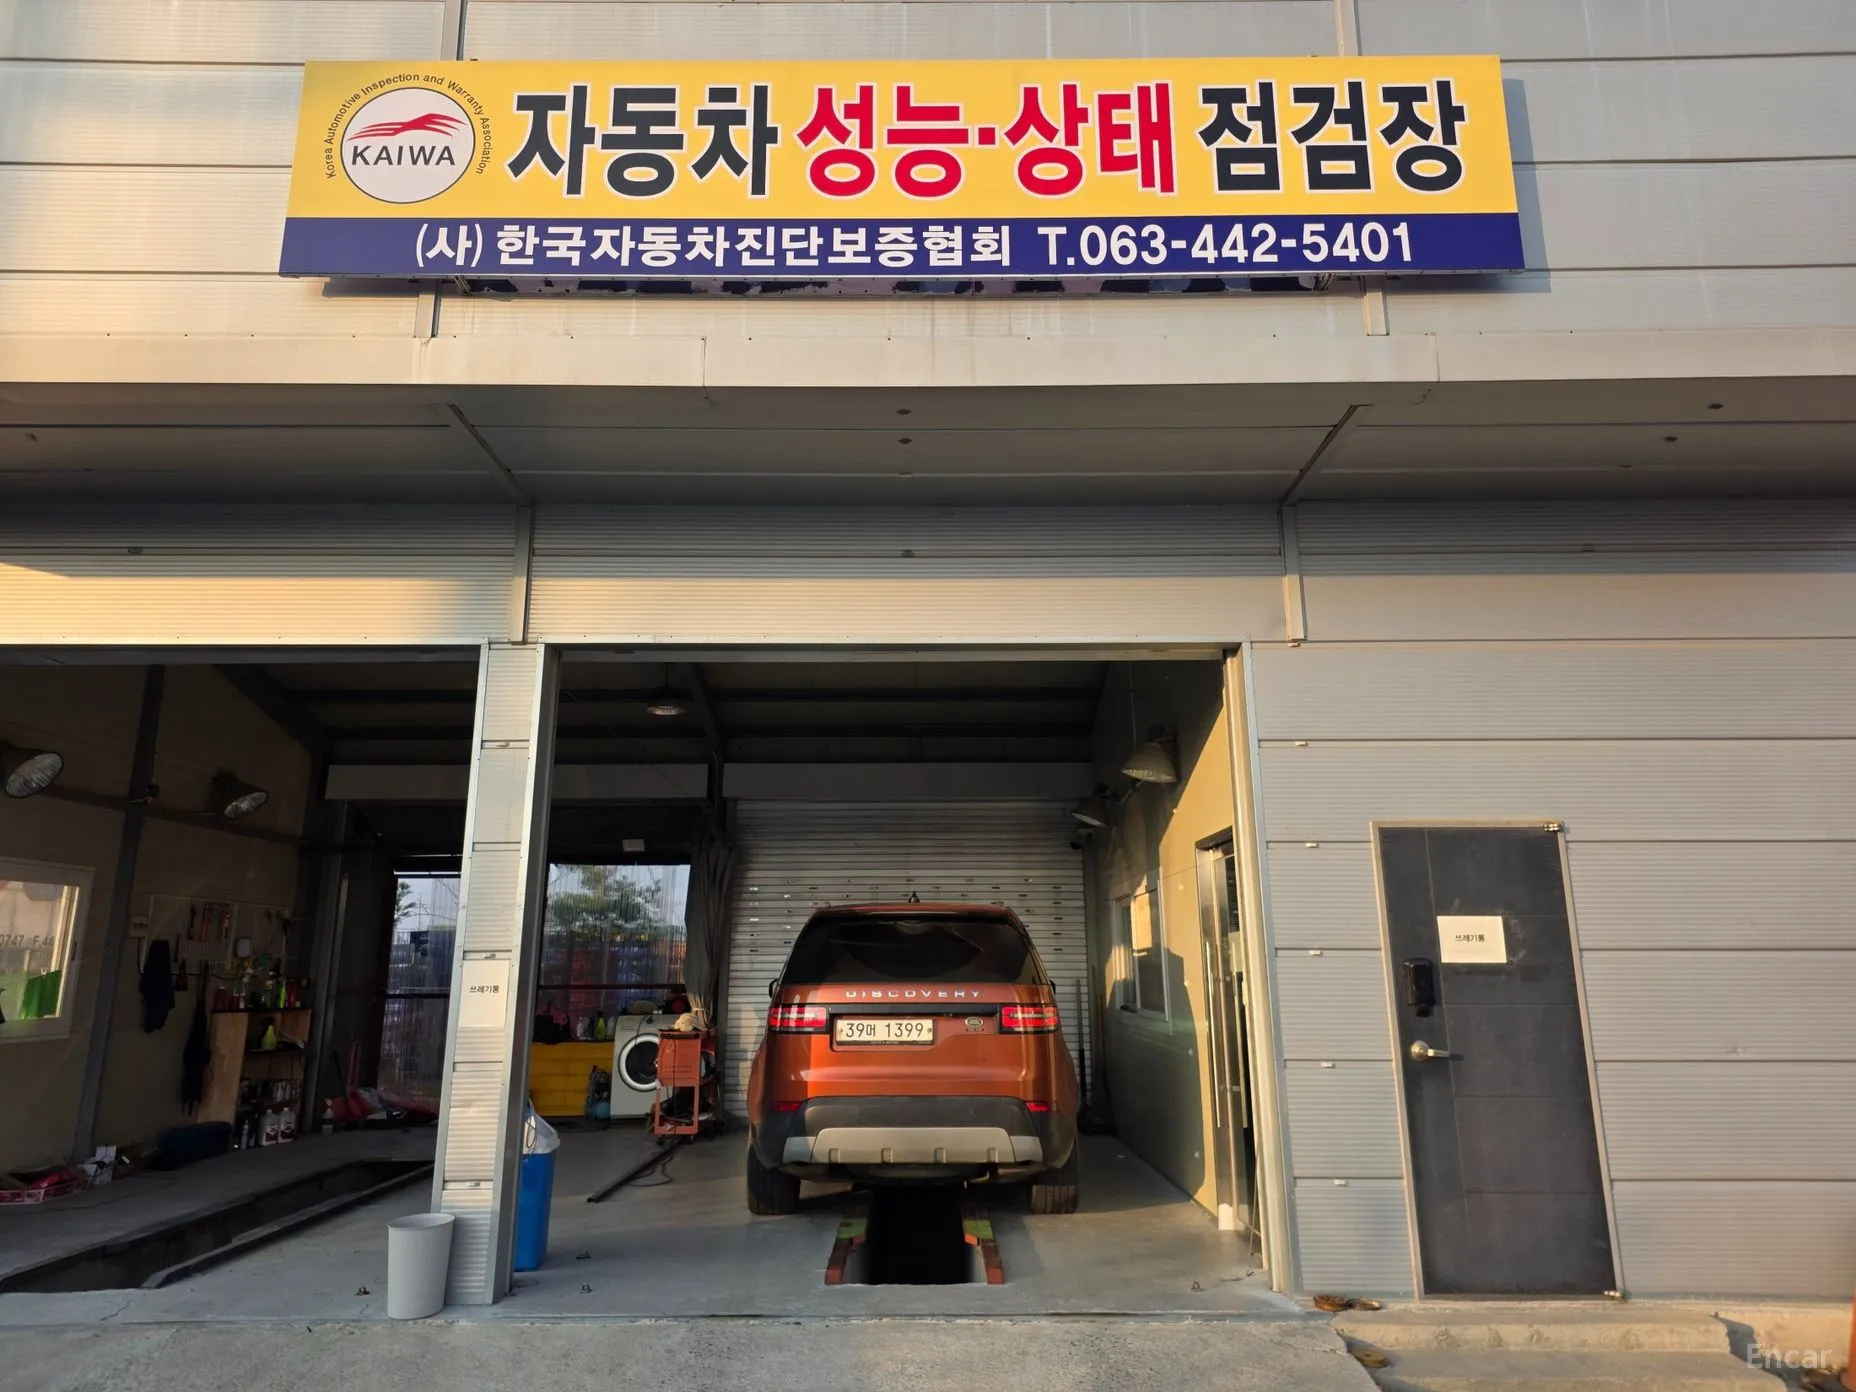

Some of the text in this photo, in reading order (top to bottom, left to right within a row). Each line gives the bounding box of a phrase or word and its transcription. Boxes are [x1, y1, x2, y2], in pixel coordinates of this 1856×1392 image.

[324, 73, 492, 179] Korea Automotive Inspection and Warranty Association
[507, 83, 779, 197] 자동차
[1198, 79, 1466, 192] 점검장
[351, 145, 456, 166] KAIWA
[415, 221, 1414, 268] (사) 한국자동차진단보증협회 T.063-442-5401
[469, 985, 500, 994] 쓰레기통
[846, 990, 980, 998] DISCOVERY
[845, 1022, 924, 1038] 39머 1399
